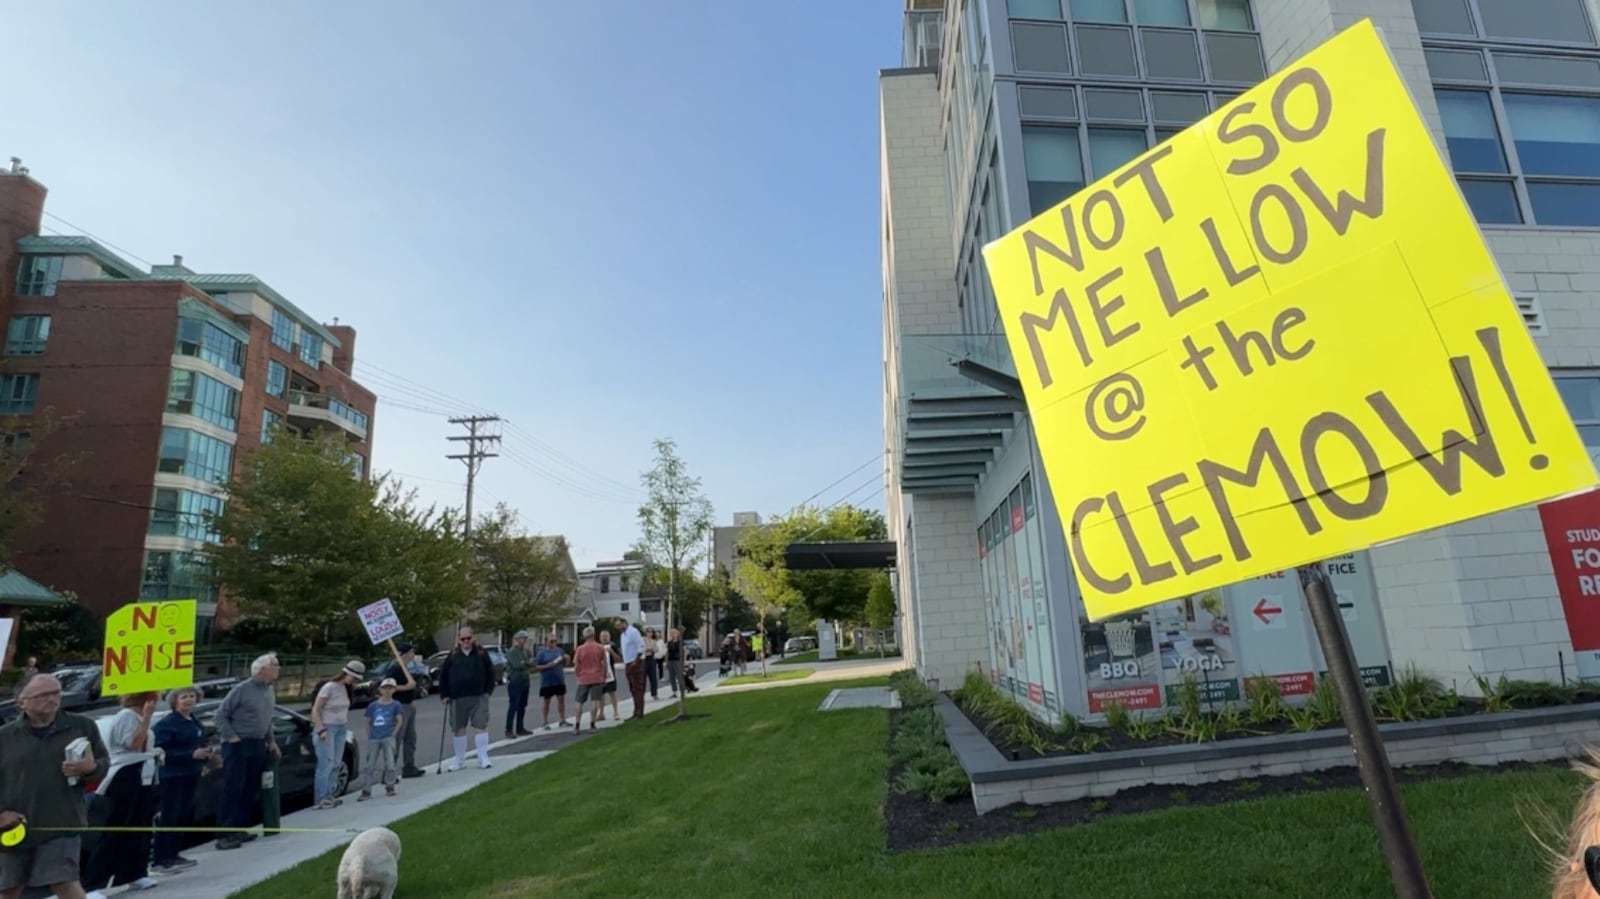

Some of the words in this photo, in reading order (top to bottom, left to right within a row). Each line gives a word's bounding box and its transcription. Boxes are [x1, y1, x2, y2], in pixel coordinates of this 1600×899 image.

[1020, 143, 1174, 297] NOT
[1215, 66, 1333, 177] SO
[1017, 127, 1387, 390] MELLOW
[1083, 372, 1147, 441] @
[1180, 306, 1316, 392] the
[1069, 326, 1550, 596] CLEMOW!
[1328, 563, 1357, 575] FICE
[132, 603, 181, 631] NO
[105, 640, 193, 677] NOISE
[1100, 660, 1140, 680] BBQ
[1172, 654, 1225, 672] YOGA
